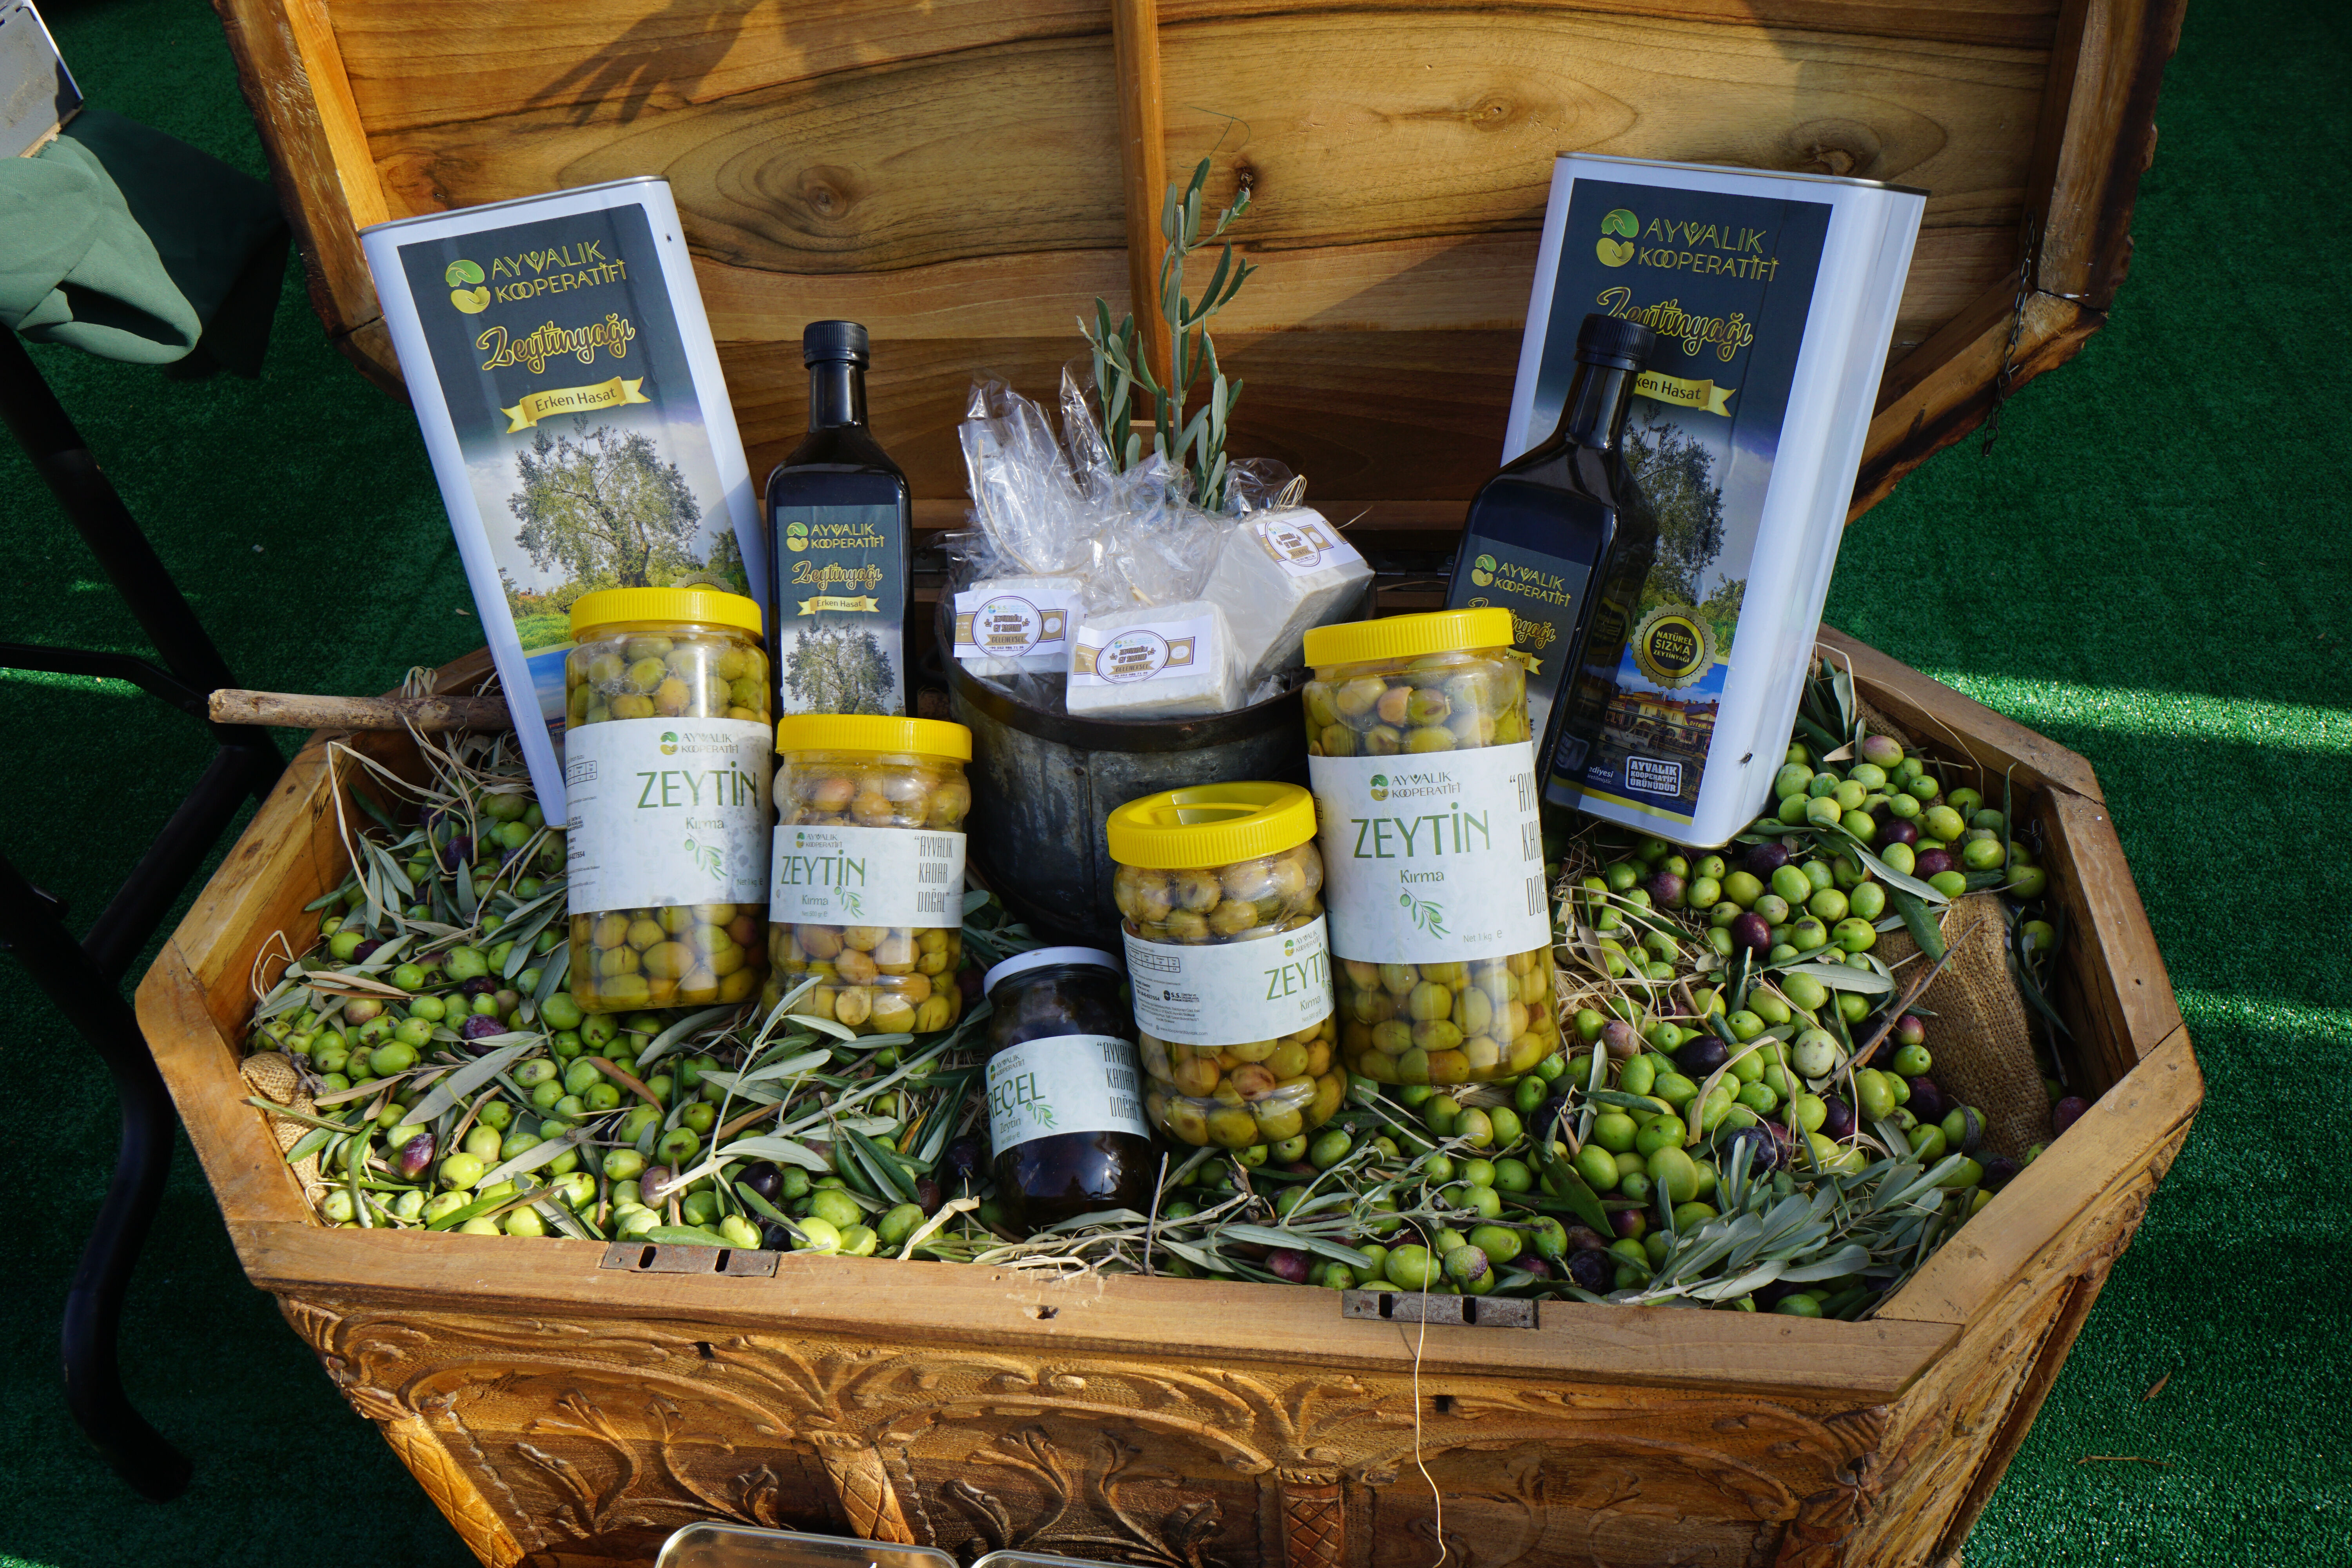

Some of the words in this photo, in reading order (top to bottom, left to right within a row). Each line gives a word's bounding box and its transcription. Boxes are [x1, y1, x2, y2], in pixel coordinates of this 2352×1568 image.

[1643, 218, 1766, 254] AYVALIK
[492, 240, 606, 280] AYVALIK
[1639, 247, 1779, 281] KOOPERATİFİ
[495, 259, 626, 303] KOOPERATİFİ
[476, 313, 635, 374] Zeytinyağı
[1661, 381, 1702, 400] Hasat
[535, 393, 575, 412] Erken
[577, 387, 617, 404] Hasat
[811, 523, 875, 537] AYVALIK
[811, 535, 885, 548] KOOPERATİFİ
[792, 560, 883, 590] Zeytinyağı
[1497, 562, 1565, 591] AYVALIK
[1494, 577, 1571, 607] KOOPERATİFİ
[817, 599, 838, 608] Erken
[840, 599, 862, 608] Hasat
[1656, 630, 1693, 646] NATÜREL
[1653, 649, 1690, 663] ZEYTİNYAĞI
[1655, 639, 1690, 656] SIZMA
[1116, 664, 1149, 673] GELENEKSEL
[681, 733, 732, 743] AYVALIK
[681, 744, 739, 754] KOOPERATİFİ
[1631, 760, 1677, 776] AYVALIK
[637, 761, 758, 808] ZEYTİN
[1392, 771, 1452, 786] AYVALIK
[1630, 777, 1675, 792] ÜRÜNÜDÜR
[1631, 771, 1677, 783] KOOPERATİFİ
[1392, 782, 1461, 799] KOOPERATİFİ
[1351, 802, 1490, 858] ZEYTİN
[781, 849, 866, 886] ZEYTİN
[919, 862, 947, 884] KADAR
[1400, 869, 1445, 884] Kırma
[802, 895, 828, 905] Kırma
[1295, 930, 1318, 945] AYVALIK
[1463, 935, 1476, 943] Net
[1483, 932, 1492, 942] kg
[1264, 942, 1331, 1000] ZEYTİN
[1300, 995, 1321, 1011] Kırma
[996, 1053, 1020, 1068] AYVALIK
[1106, 1067, 1135, 1093] KADAR
[988, 1072, 1045, 1122] REÇEL
[1000, 1116, 1021, 1134] Zeytin
